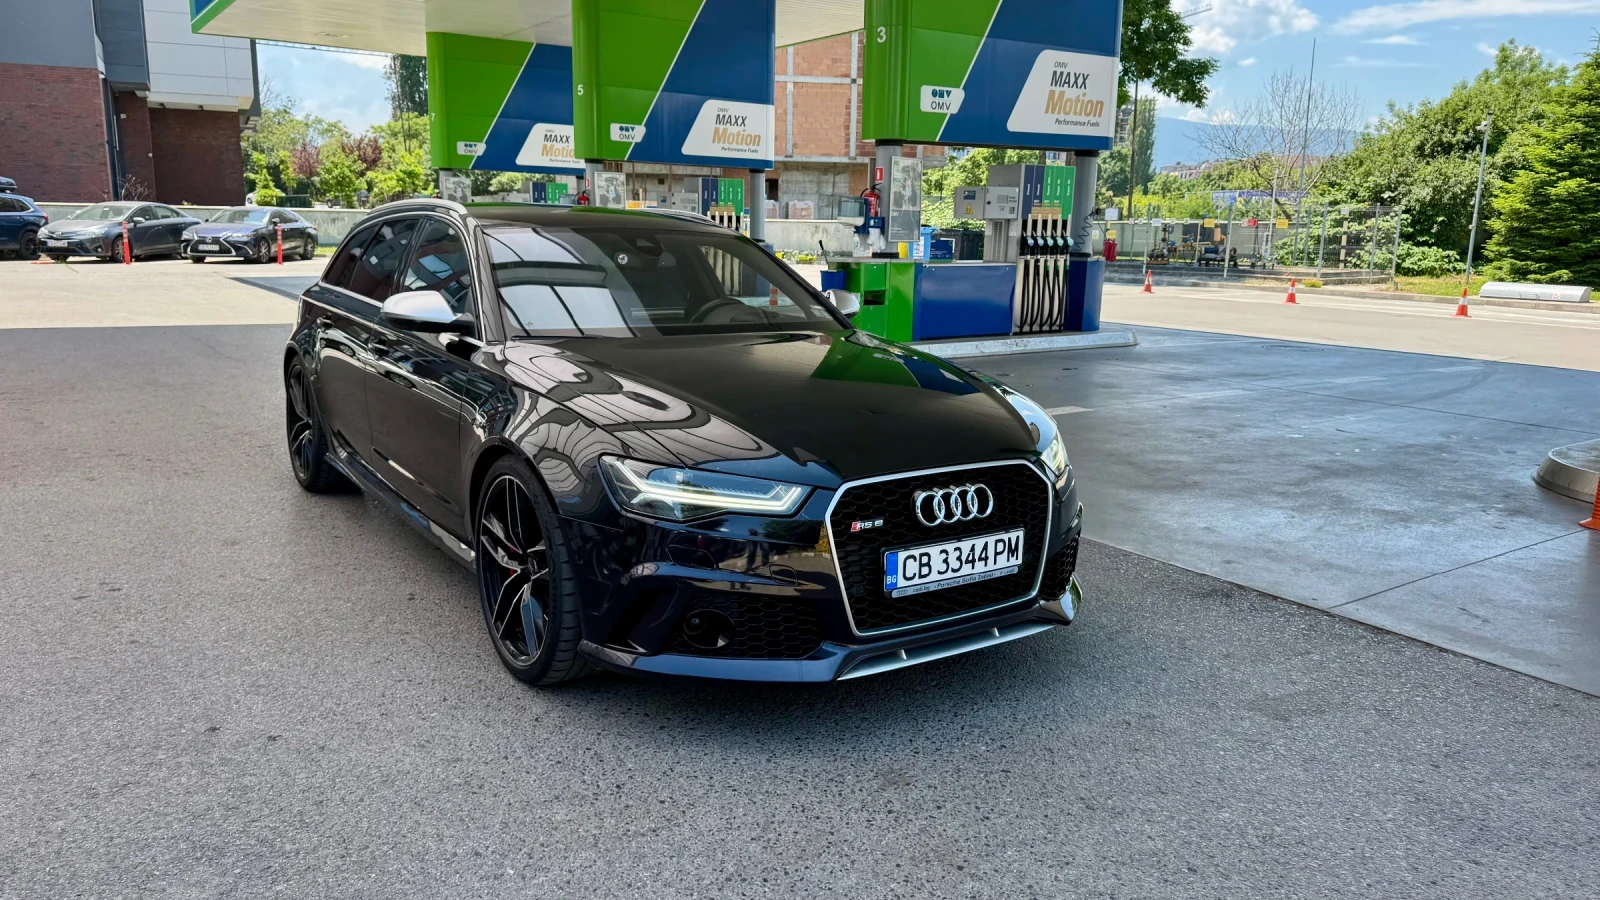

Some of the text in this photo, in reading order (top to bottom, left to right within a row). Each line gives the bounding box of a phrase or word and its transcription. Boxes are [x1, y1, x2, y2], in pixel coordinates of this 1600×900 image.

[876, 26, 887, 43] 3
[1054, 61, 1068, 69] OMV
[1050, 70, 1090, 90] MAXX
[577, 84, 584, 96] 5
[931, 101, 952, 111] OMV
[1044, 89, 1104, 118] Motion
[715, 113, 748, 128] MAXX
[1055, 118, 1100, 128] Performance Fuels
[543, 133, 571, 144] MAXX
[618, 133, 636, 141] OMV
[712, 126, 762, 147] Motion
[541, 143, 575, 158] Motio
[902, 535, 1020, 581] CB 3344 PM
[886, 575, 897, 584] BG
[936, 580, 961, 589] Porsche
[961, 576, 977, 584] Sofia
